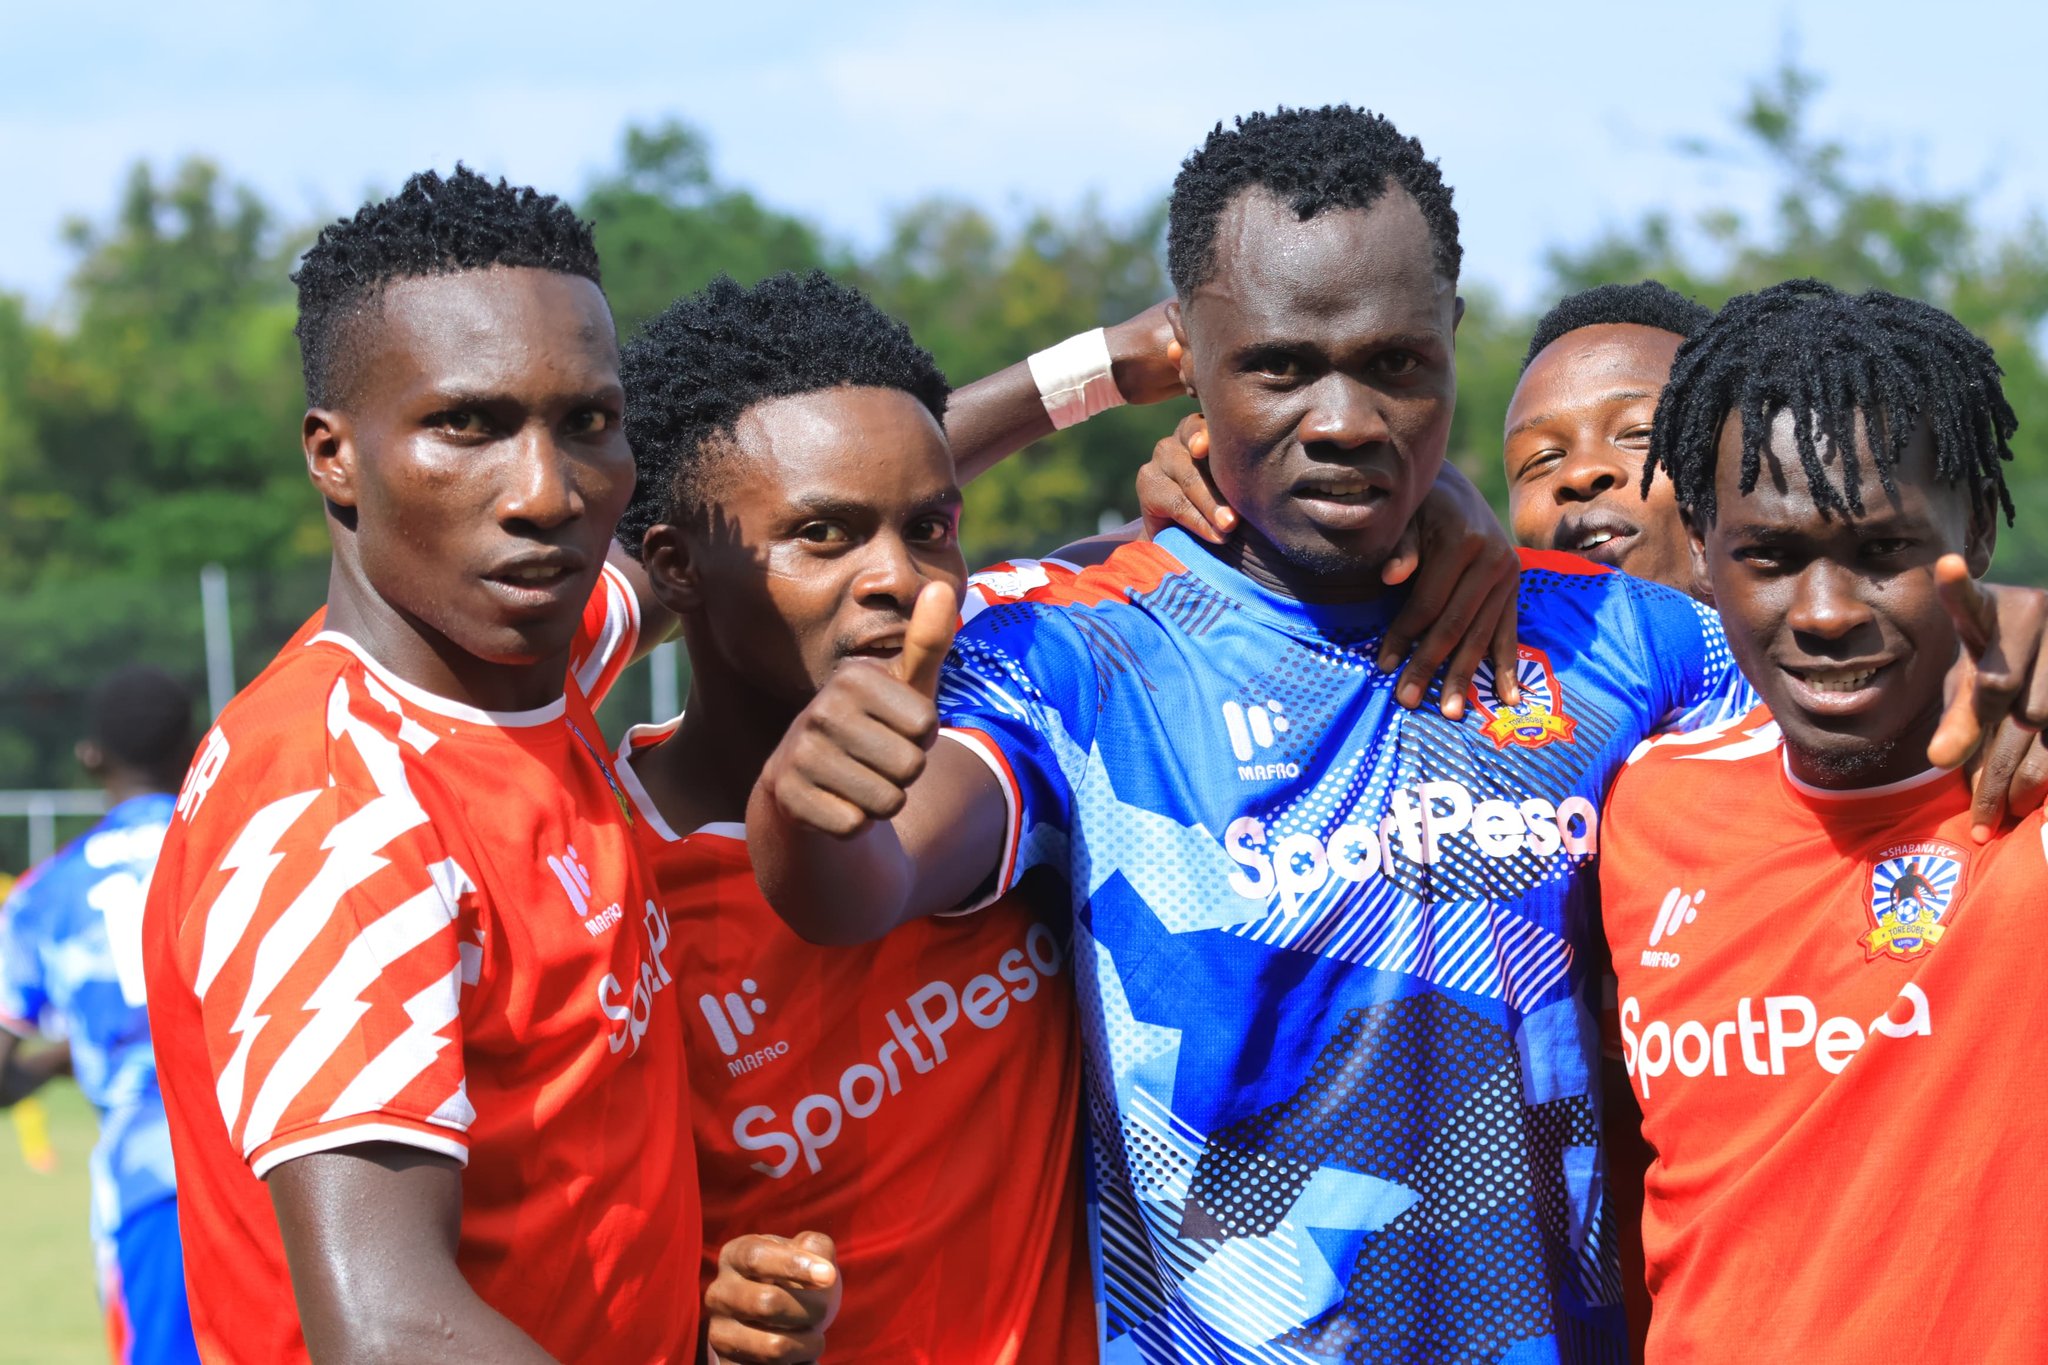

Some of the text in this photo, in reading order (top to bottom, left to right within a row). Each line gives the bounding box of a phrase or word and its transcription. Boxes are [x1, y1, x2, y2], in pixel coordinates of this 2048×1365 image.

[1237, 762, 1299, 781] MAFRO
[1224, 780, 1598, 918] SportPesa
[1888, 843, 1948, 857] SHABANA FC
[584, 902, 623, 937] MAFRO
[1888, 924, 1925, 937] TORE BOBE
[1640, 950, 1681, 968] MAFRO
[732, 922, 1063, 1179] SportPesa
[1620, 981, 1932, 1100] SportPea
[726, 1040, 790, 1079] MAFRO
